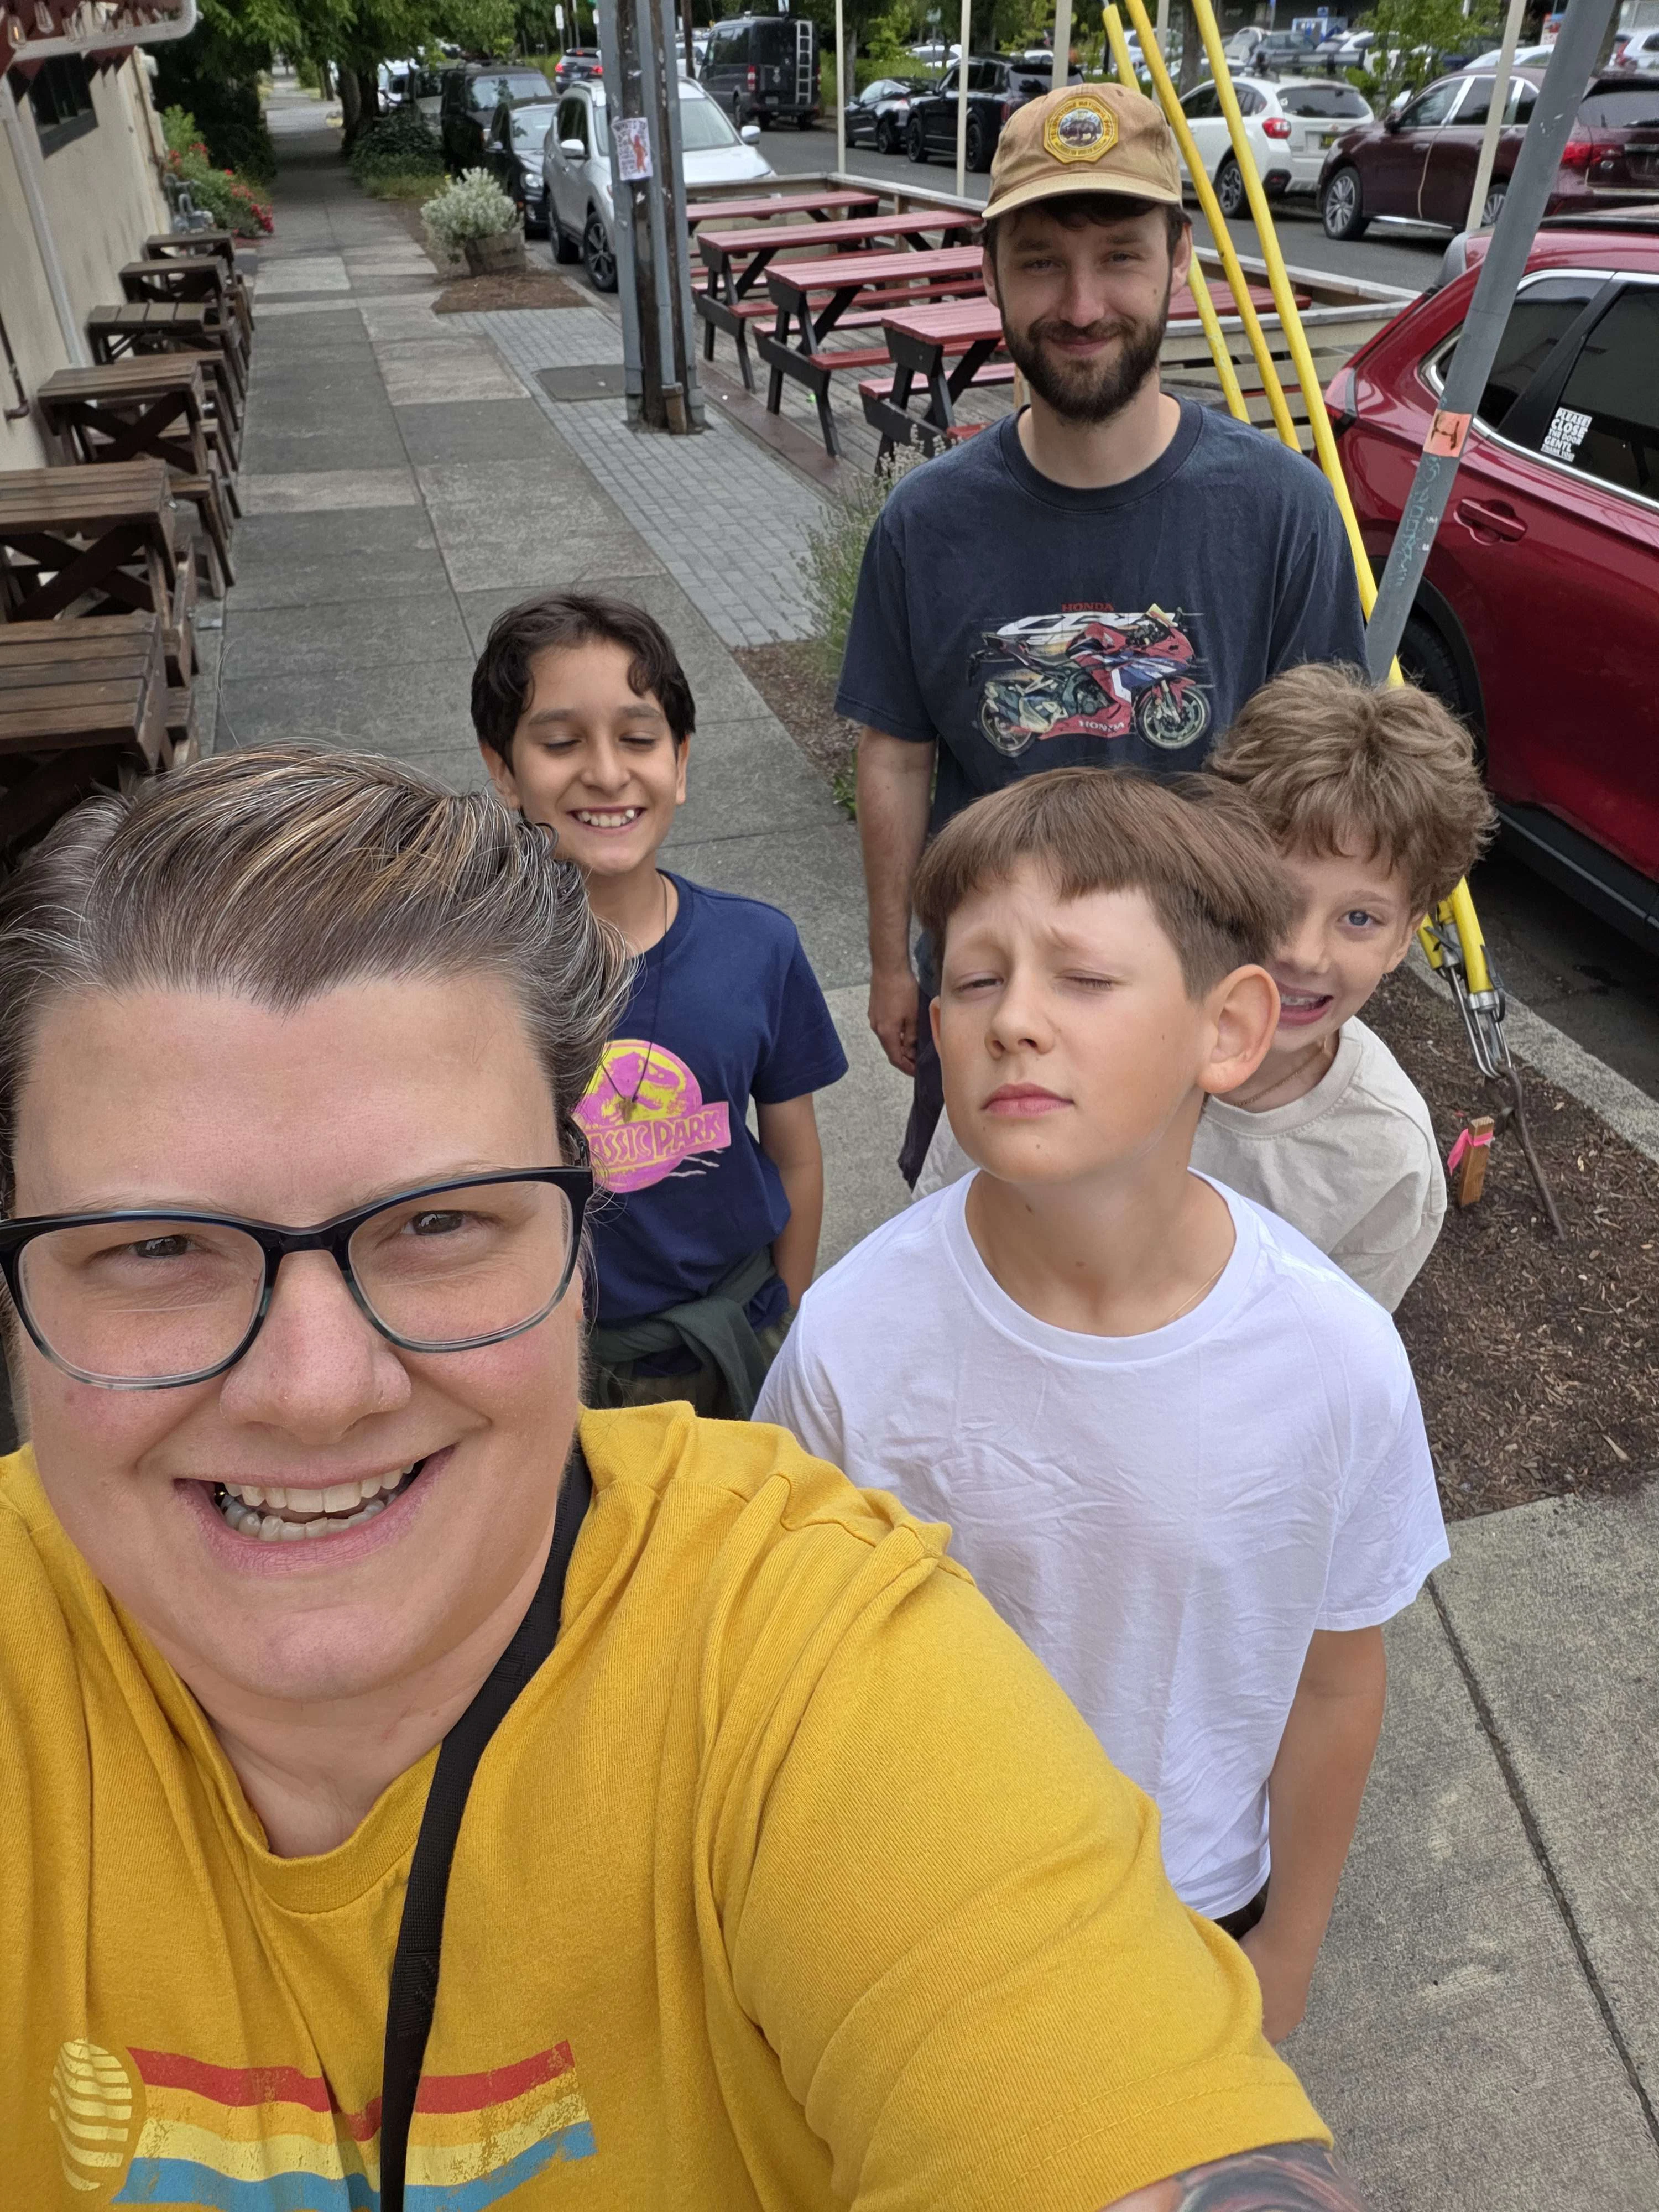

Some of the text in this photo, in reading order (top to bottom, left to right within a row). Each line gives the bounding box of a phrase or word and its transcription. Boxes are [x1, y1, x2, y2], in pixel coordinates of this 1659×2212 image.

[1549, 427, 1582, 446] THE DOOR
[1551, 418, 1588, 439] CLOSE
[1061, 602, 1115, 611] HONDA
[589, 1111, 722, 1164] ASSIC PARK
